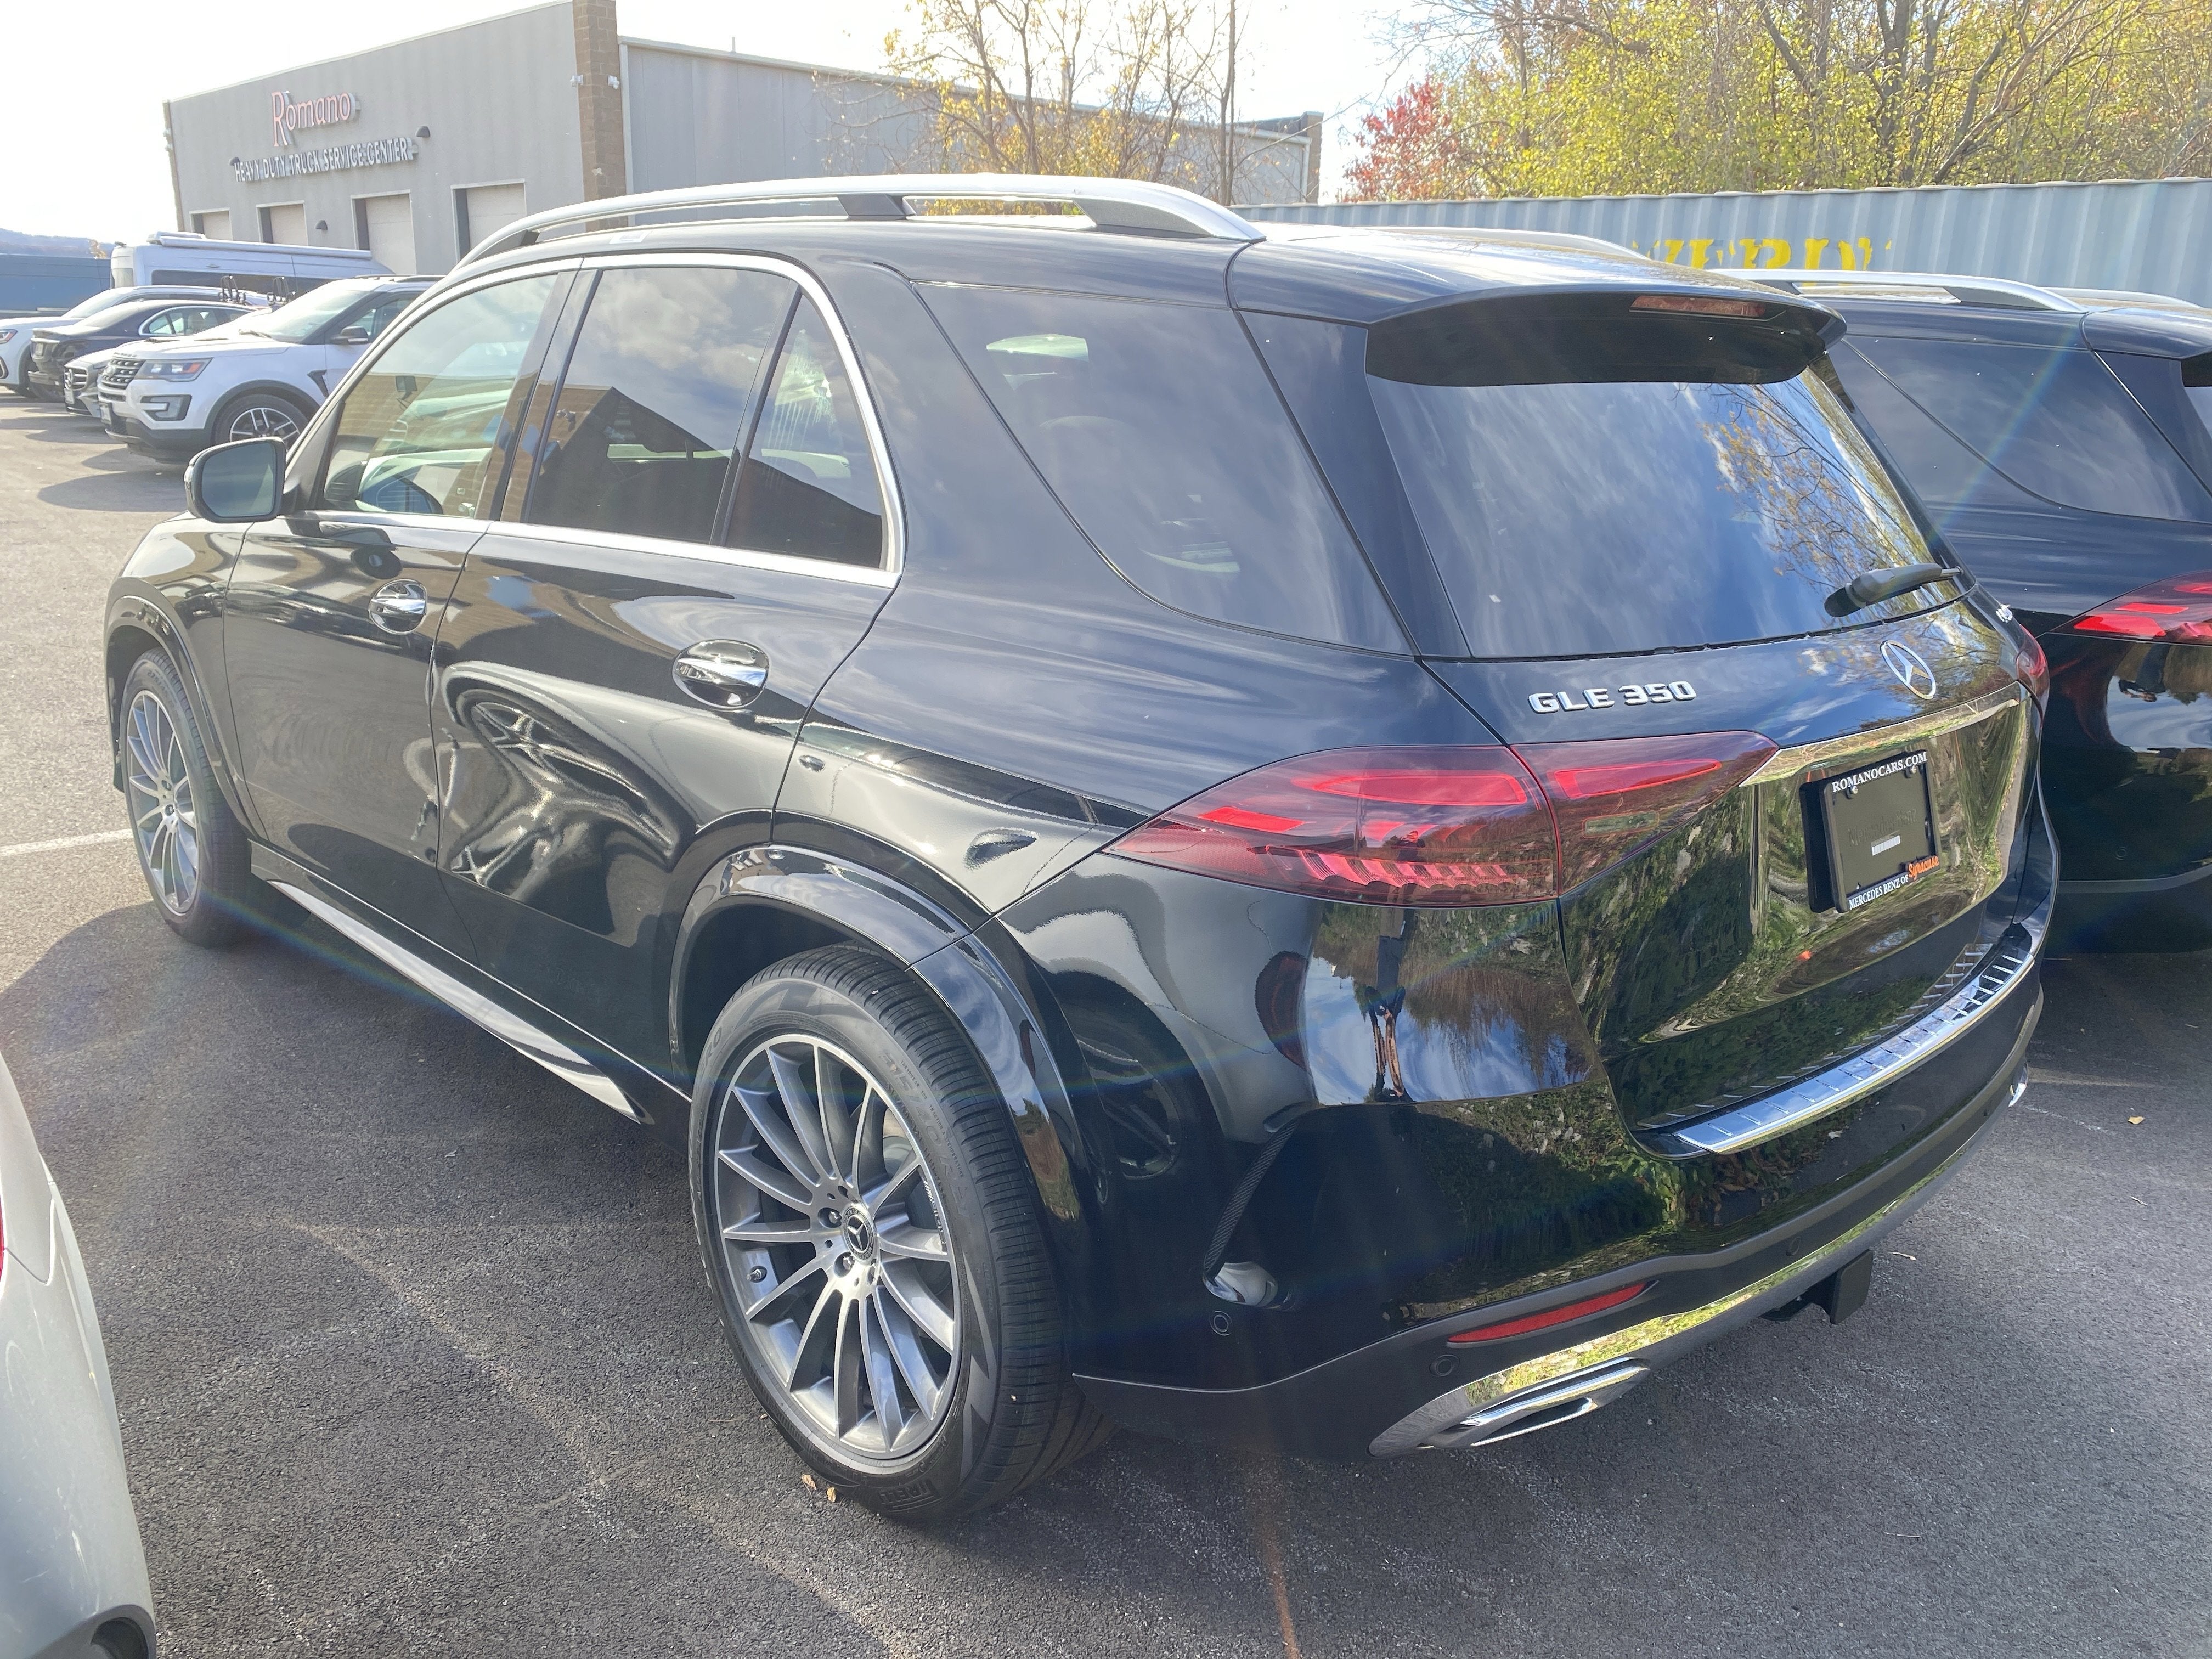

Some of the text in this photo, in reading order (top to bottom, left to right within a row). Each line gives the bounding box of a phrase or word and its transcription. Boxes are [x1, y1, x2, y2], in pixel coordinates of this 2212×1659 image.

[272, 91, 352, 146] Romano
[234, 136, 409, 182] HEAVY DUTY TRUCK SERVICE CENTER
[1528, 680, 1697, 714] GLE 350
[1831, 751, 1928, 793] ROMANOCARS.COM
[1908, 855, 1940, 881] Syracuse
[1848, 874, 1909, 910] MERCEDES BENZ OF
